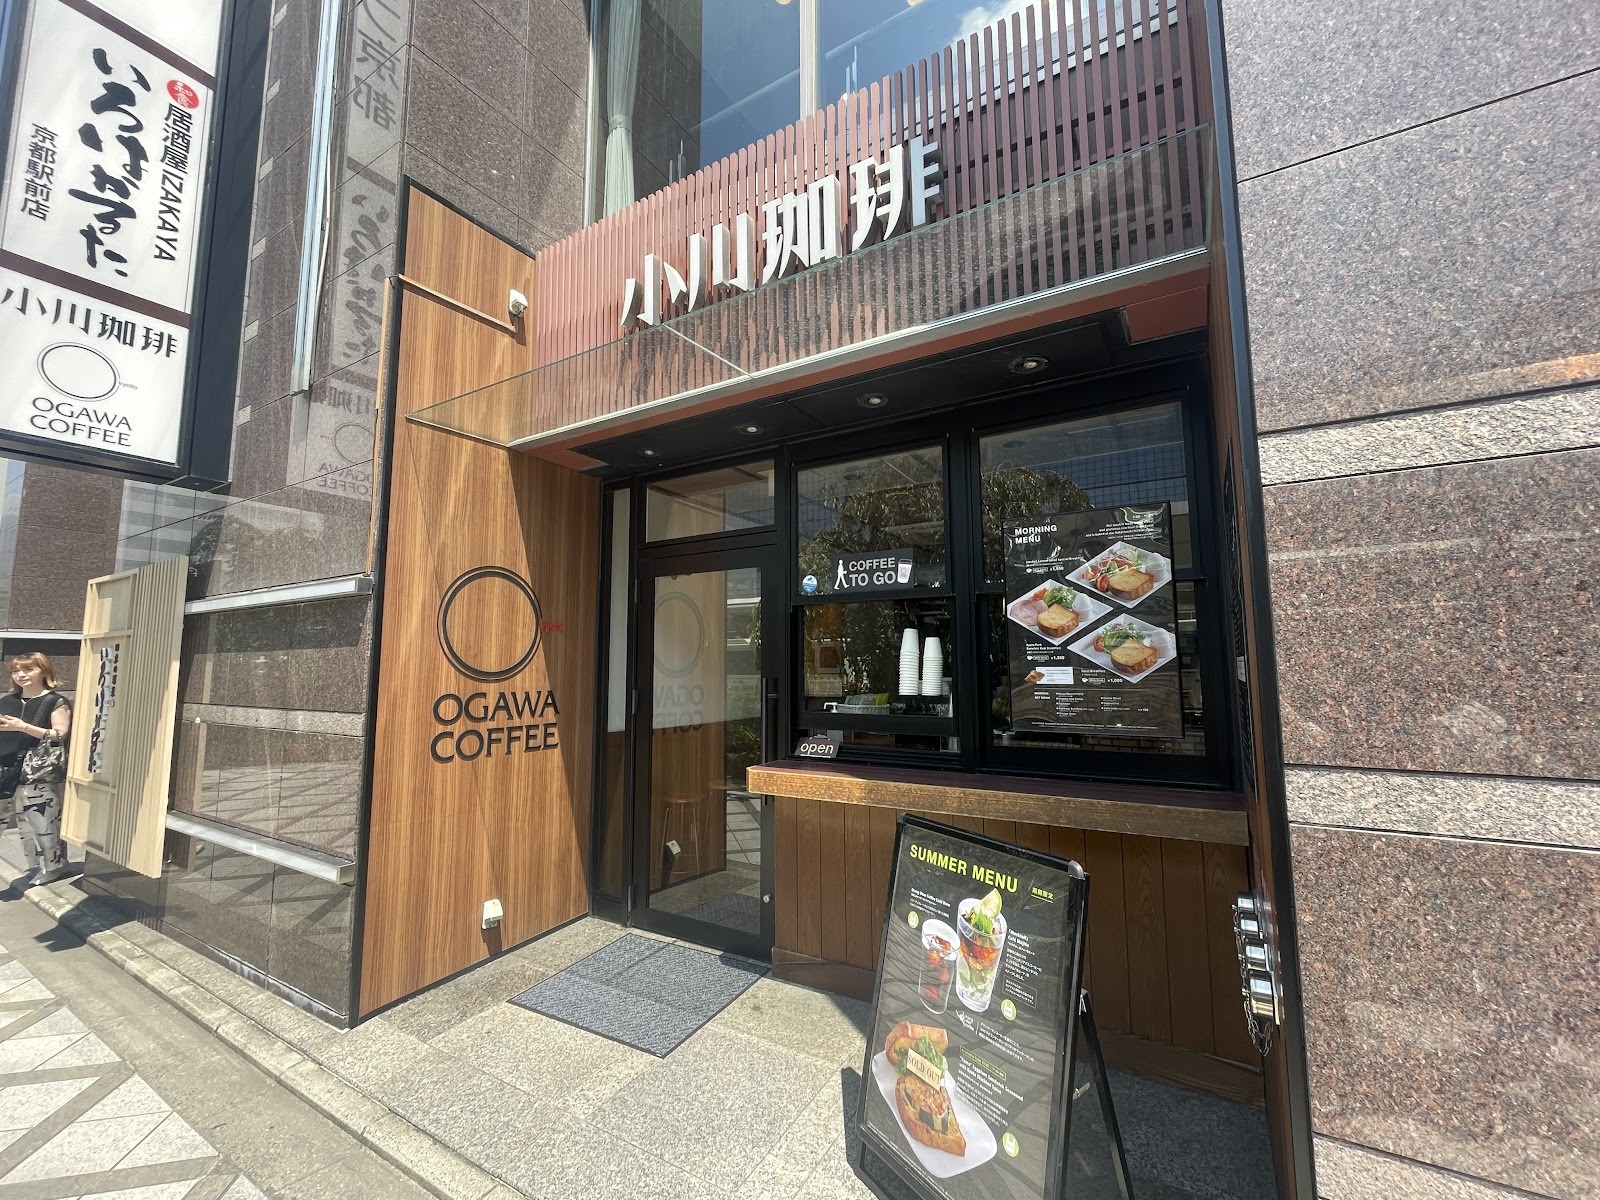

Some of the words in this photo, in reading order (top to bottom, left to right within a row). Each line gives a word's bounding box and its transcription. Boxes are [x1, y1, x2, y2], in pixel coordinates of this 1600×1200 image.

[20, 122, 58, 222] 京都駅前店
[621, 135, 944, 328] 小川珈琲
[0, 286, 178, 358] 小川珈琲
[118, 380, 138, 390] kyoto
[30, 414, 132, 447] COFFEE
[32, 397, 133, 431] OGAWA
[1014, 524, 1058, 536] MORNING
[1014, 535, 1041, 544] MENU
[848, 557, 896, 571] COFFEE
[848, 573, 869, 588] TO
[872, 570, 896, 585] GO
[432, 690, 560, 726] OGAWA
[430, 722, 559, 764] COFFEE
[800, 742, 834, 755] open
[910, 844, 968, 876] SUMMER
[972, 865, 1018, 893] MENU
[908, 1055, 925, 1072] SOLD
[927, 1068, 941, 1085] OUT
